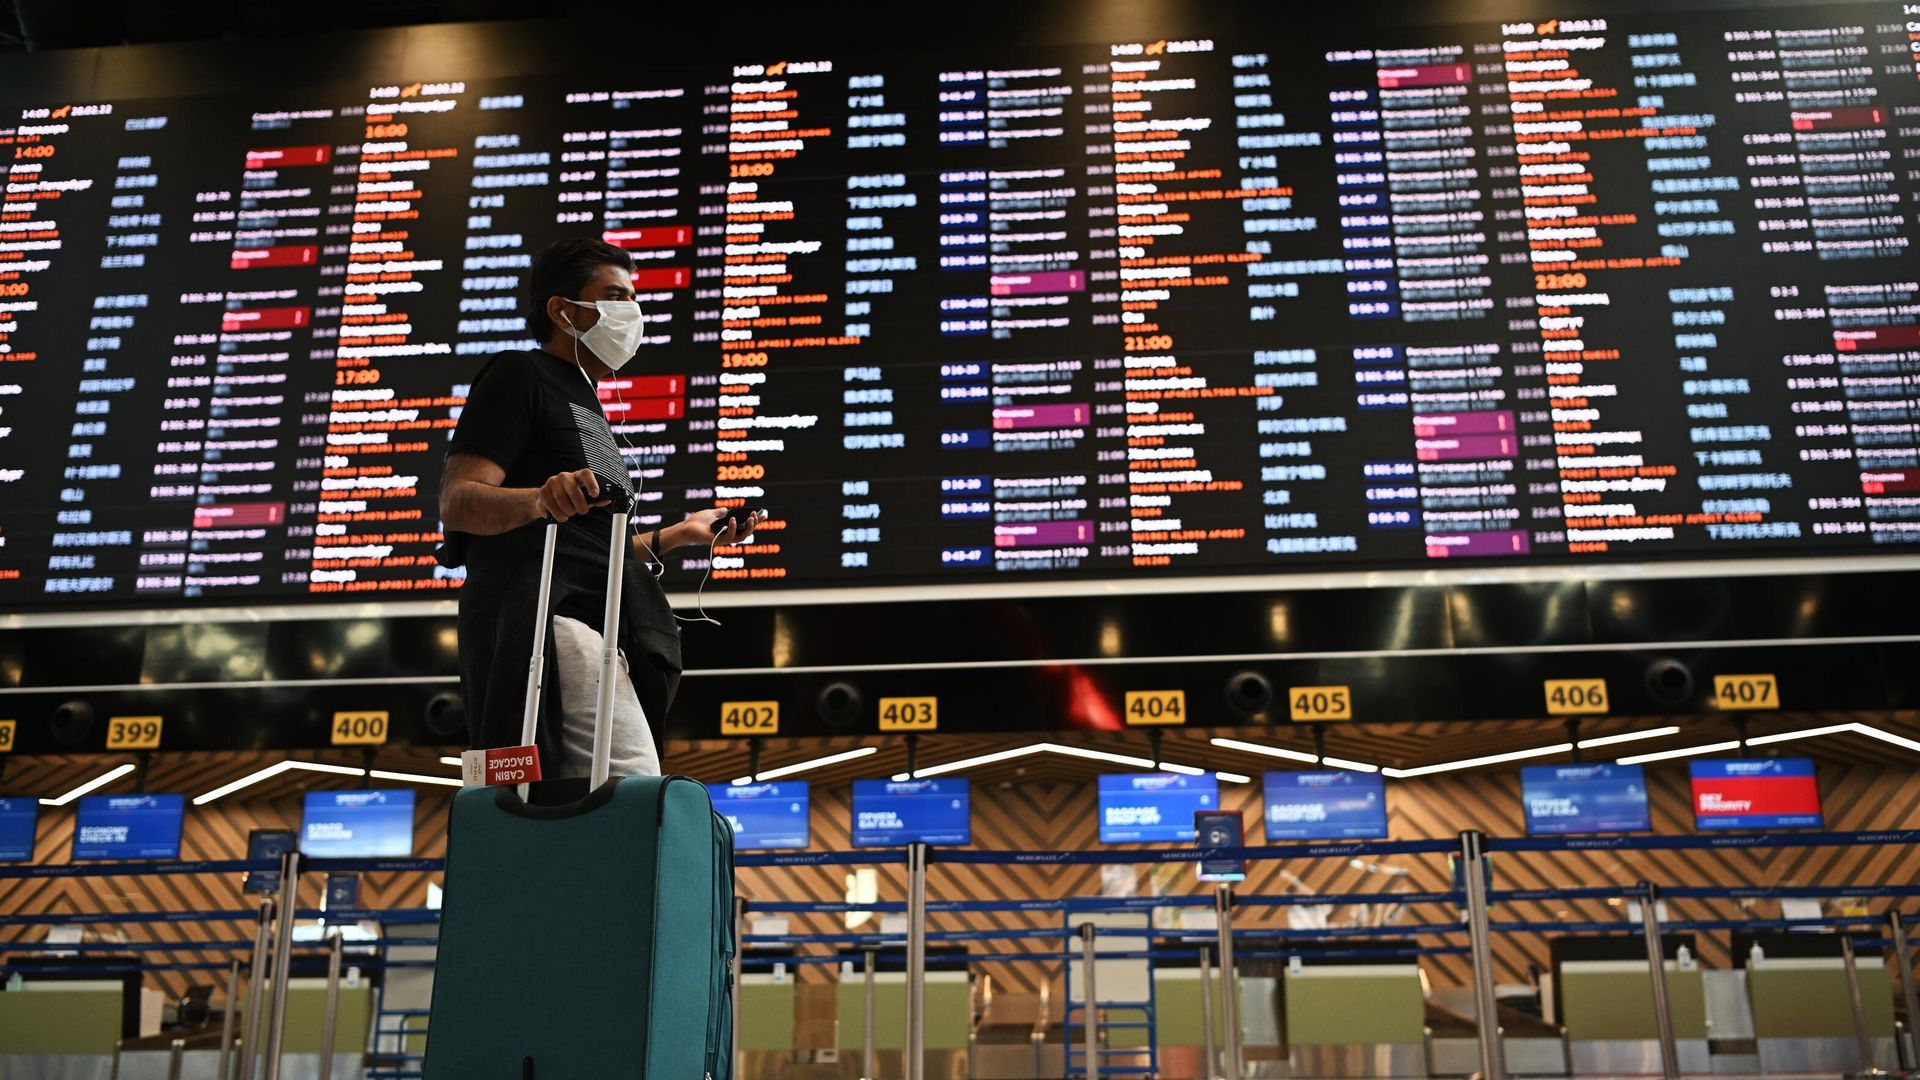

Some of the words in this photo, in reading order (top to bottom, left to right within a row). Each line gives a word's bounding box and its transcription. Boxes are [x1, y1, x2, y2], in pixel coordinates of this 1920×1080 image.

[365, 123, 408, 139] 16:00
[14, 144, 55, 159] 14:00
[729, 163, 774, 177] 18:00
[1535, 273, 1587, 290] 22:00
[1124, 335, 1173, 351] 21:00
[722, 352, 768, 368] 19:00
[335, 369, 380, 385] 17:00
[716, 464, 765, 481] 20:00
[1550, 686, 1603, 707] 406
[1721, 681, 1772, 702] 407
[1130, 696, 1180, 717] 404
[1295, 692, 1345, 714] 405
[725, 707, 774, 728] 402
[883, 703, 932, 724] 403
[112, 722, 158, 743] 399
[336, 718, 384, 737] 400
[489, 756, 533, 769] BAGGAGE
[496, 770, 524, 781] CABIN
[1700, 802, 1751, 811] PRIORITY
